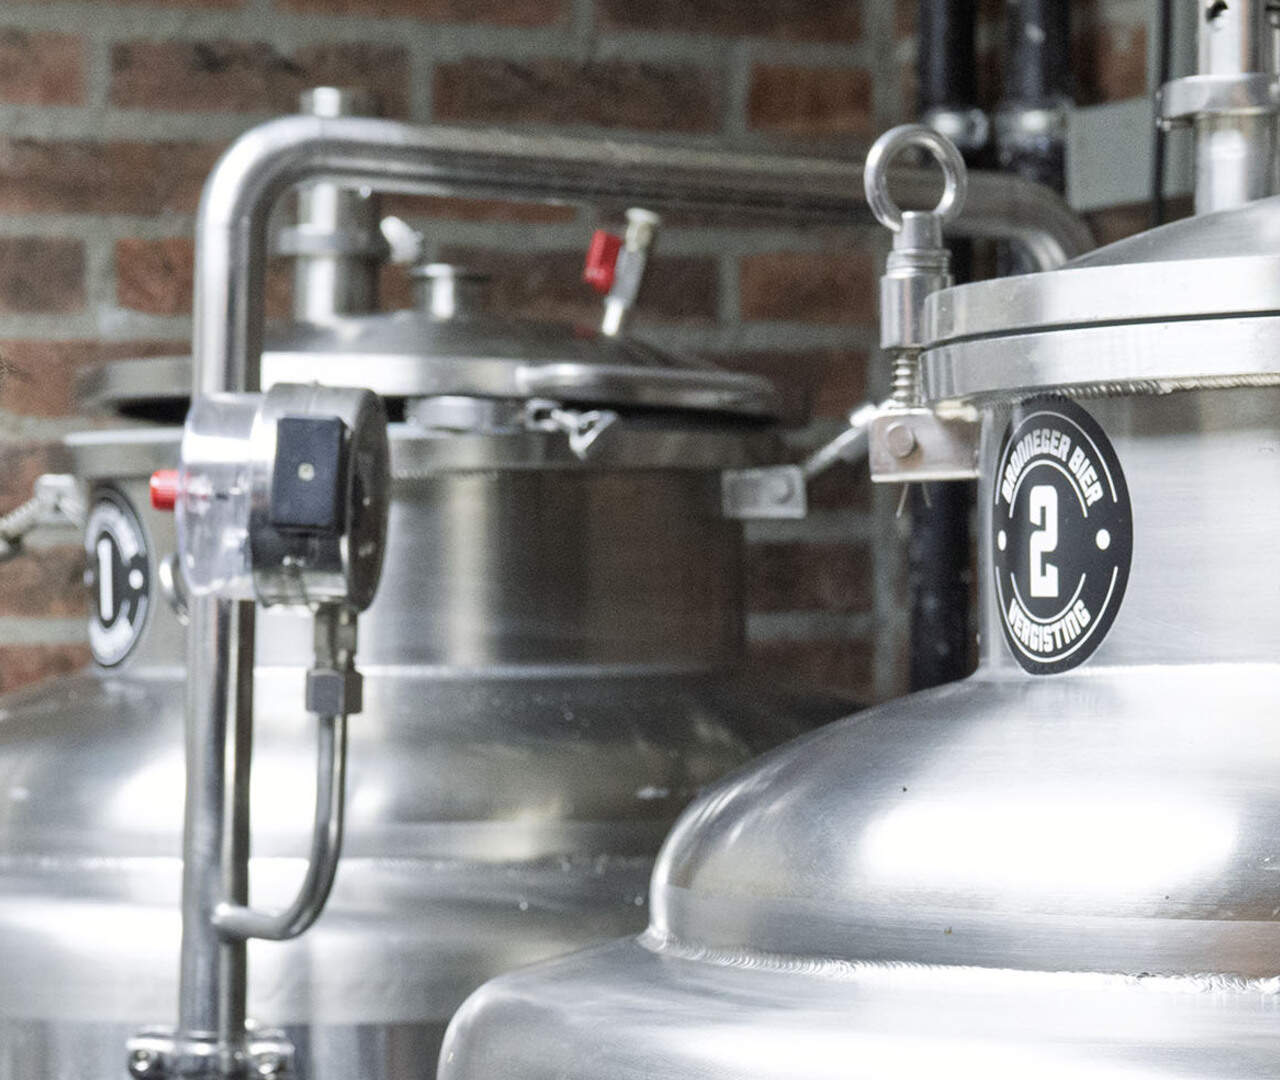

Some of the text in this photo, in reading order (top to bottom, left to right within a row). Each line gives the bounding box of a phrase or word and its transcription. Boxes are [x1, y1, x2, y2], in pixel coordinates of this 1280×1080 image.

[1001, 428, 1105, 507] BRONNEGER BIER
[1029, 485, 1059, 597] 2
[1008, 598, 1091, 652] VERGISTING
